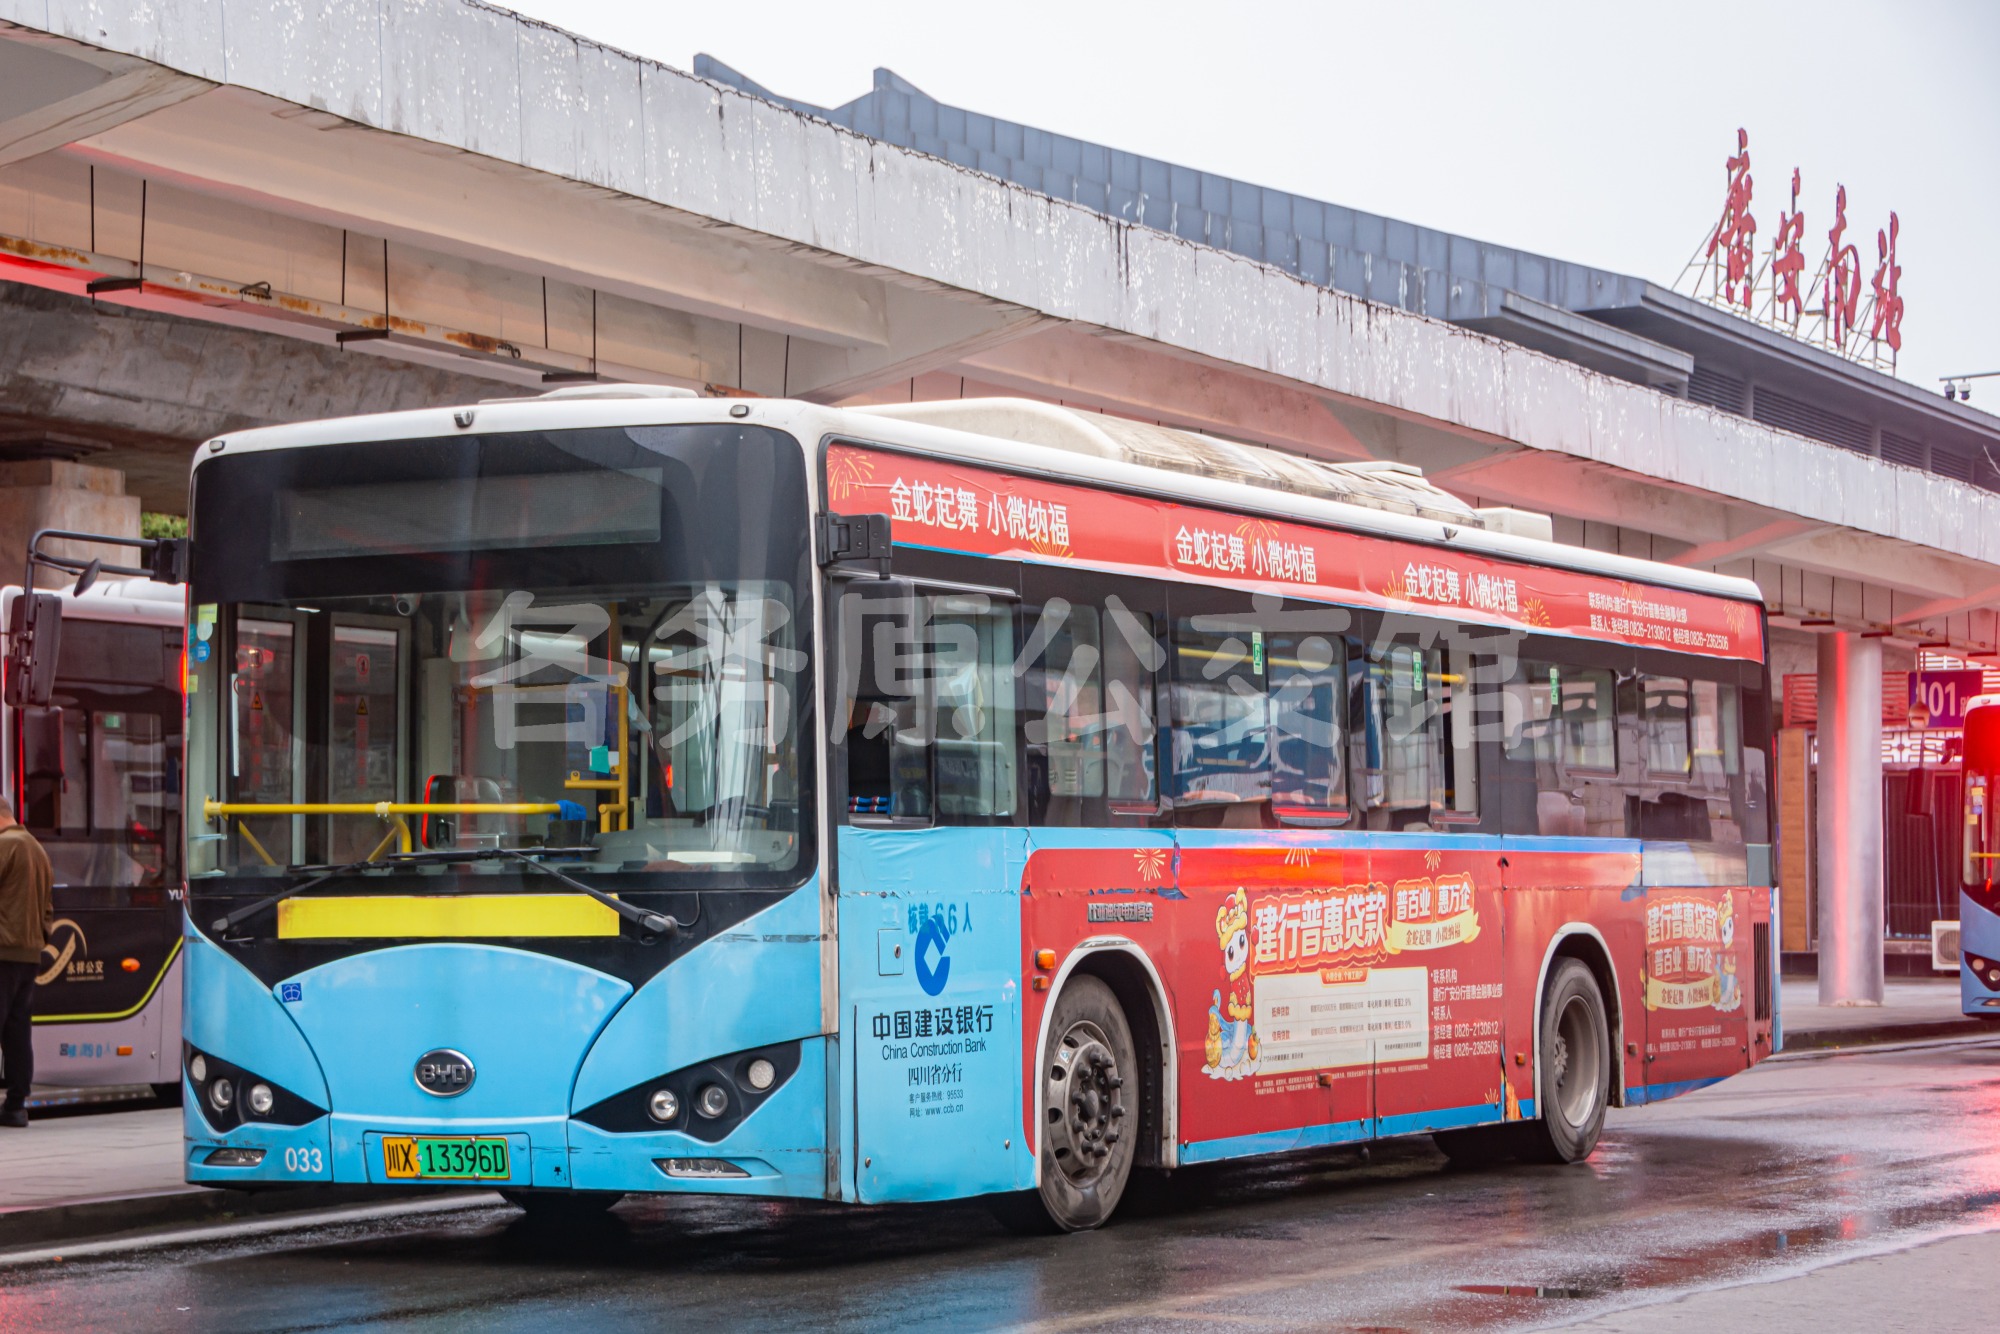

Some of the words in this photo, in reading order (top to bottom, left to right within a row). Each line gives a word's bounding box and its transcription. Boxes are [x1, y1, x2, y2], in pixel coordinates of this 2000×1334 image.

[889, 476, 979, 533] 金蛇起舞
[987, 493, 1070, 546] 小微纳福
[1175, 525, 1247, 574] 金蛇起舞
[1252, 538, 1317, 583] 小微纳福
[1403, 561, 1461, 604] 金蛇起舞
[1465, 571, 1518, 612] 小微纳福
[1396, 886, 1431, 920] 普百业
[1438, 881, 1471, 915] 惠万企
[1254, 891, 1387, 965] 建行普惠贷款
[1647, 902, 1719, 944] 建行普惠贷款
[1655, 946, 1682, 976] 普百业
[1687, 945, 1713, 974] 惠万企
[873, 1004, 994, 1040] 中国建设银行
[1433, 1005, 1452, 1020] 联系人
[1454, 1020, 1499, 1038] 0826-2130612
[882, 1043, 908, 1060] China
[910, 1039, 963, 1058] Construction
[965, 1037, 987, 1053] Bank
[1454, 1040, 1499, 1057] 0826-2362506
[421, 1064, 467, 1084] BYD
[908, 1062, 963, 1086] 四川省分行
[946, 1089, 964, 1100] 95533
[285, 1147, 323, 1173] 033
[387, 1143, 414, 1172] 川X
[425, 1144, 506, 1173] 13396D
